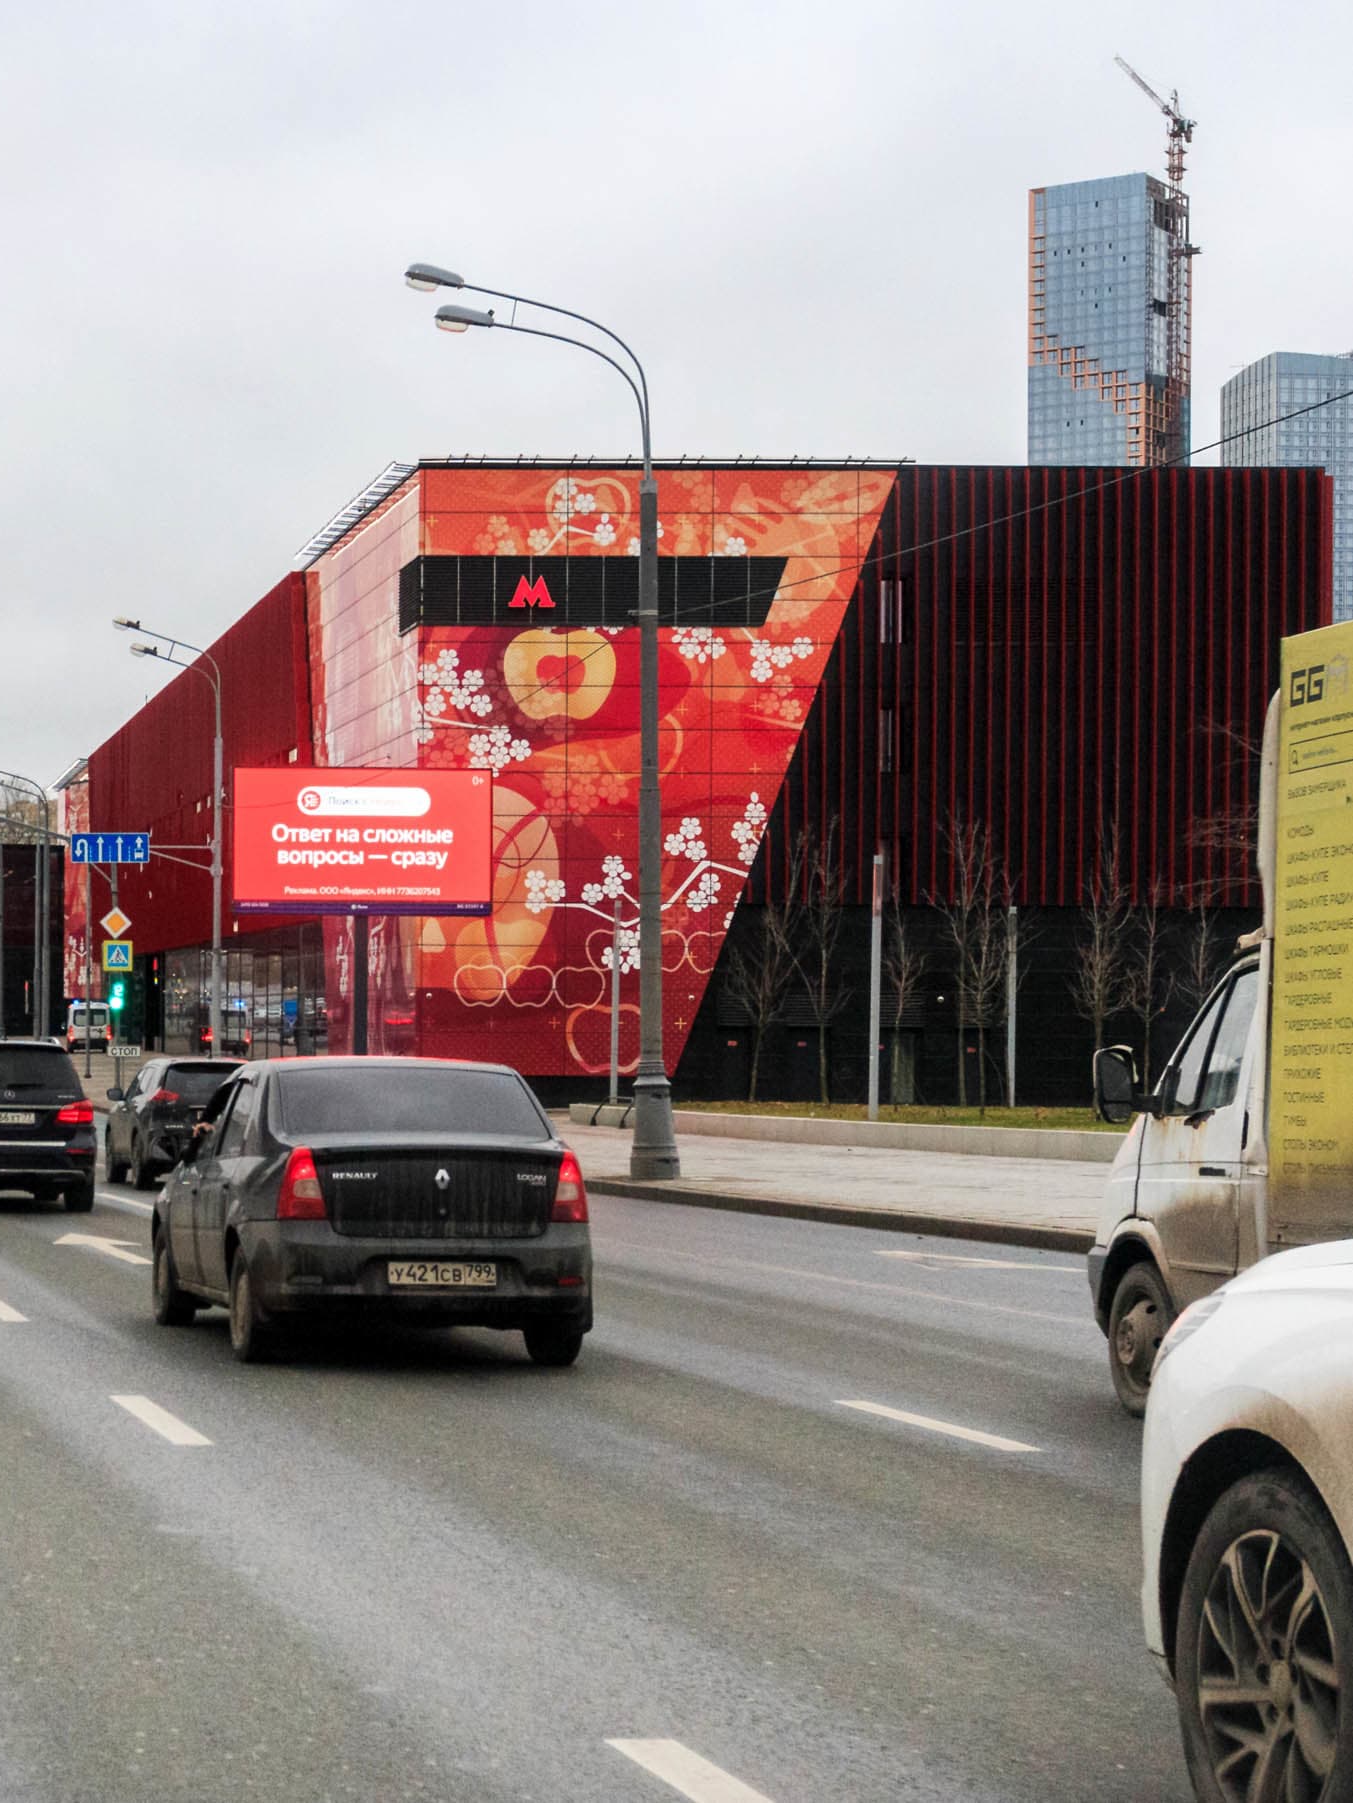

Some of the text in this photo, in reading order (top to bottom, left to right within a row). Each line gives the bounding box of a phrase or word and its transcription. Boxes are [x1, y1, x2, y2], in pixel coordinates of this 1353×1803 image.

[508, 574, 556, 608] М
[271, 823, 453, 843] Ответ на сложные
[277, 850, 364, 868] вопросы
[391, 851, 448, 869] сразу
[319, 886, 339, 895] ООО
[111, 1047, 138, 1056] СТОП
[332, 1172, 378, 1180] RENAULT
[517, 1173, 547, 1182] LOGAN
